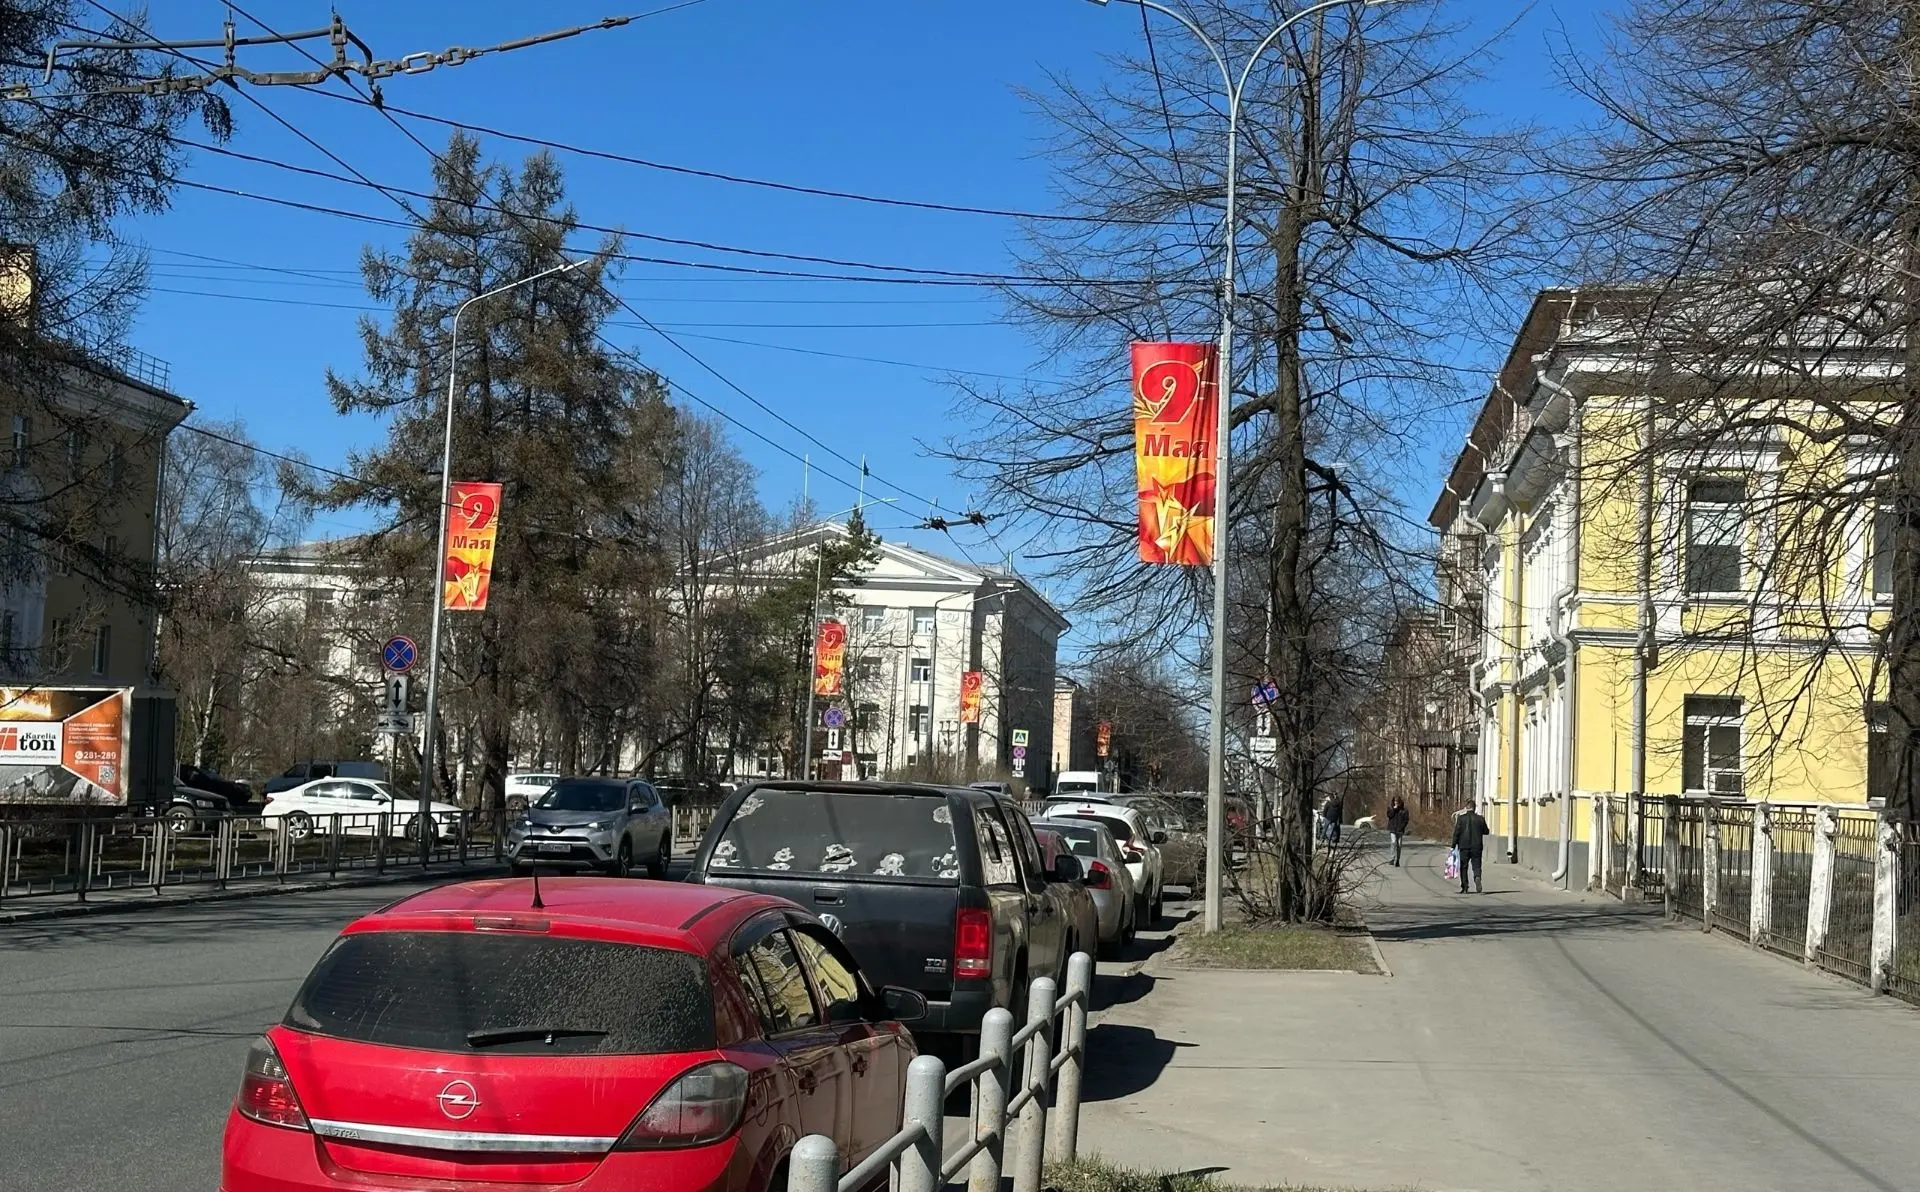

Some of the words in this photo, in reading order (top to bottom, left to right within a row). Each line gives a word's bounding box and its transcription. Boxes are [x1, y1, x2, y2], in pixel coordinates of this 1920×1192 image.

[1139, 360, 1200, 426] 9
[1144, 434, 1209, 459] Мая
[461, 492, 496, 531] 9
[452, 535, 491, 550] Мая
[824, 629, 844, 650] 9
[19, 735, 56, 751] ton
[25, 732, 56, 740] Karelia
[926, 958, 947, 966] TDI
[323, 1127, 360, 1139] ASTRA
